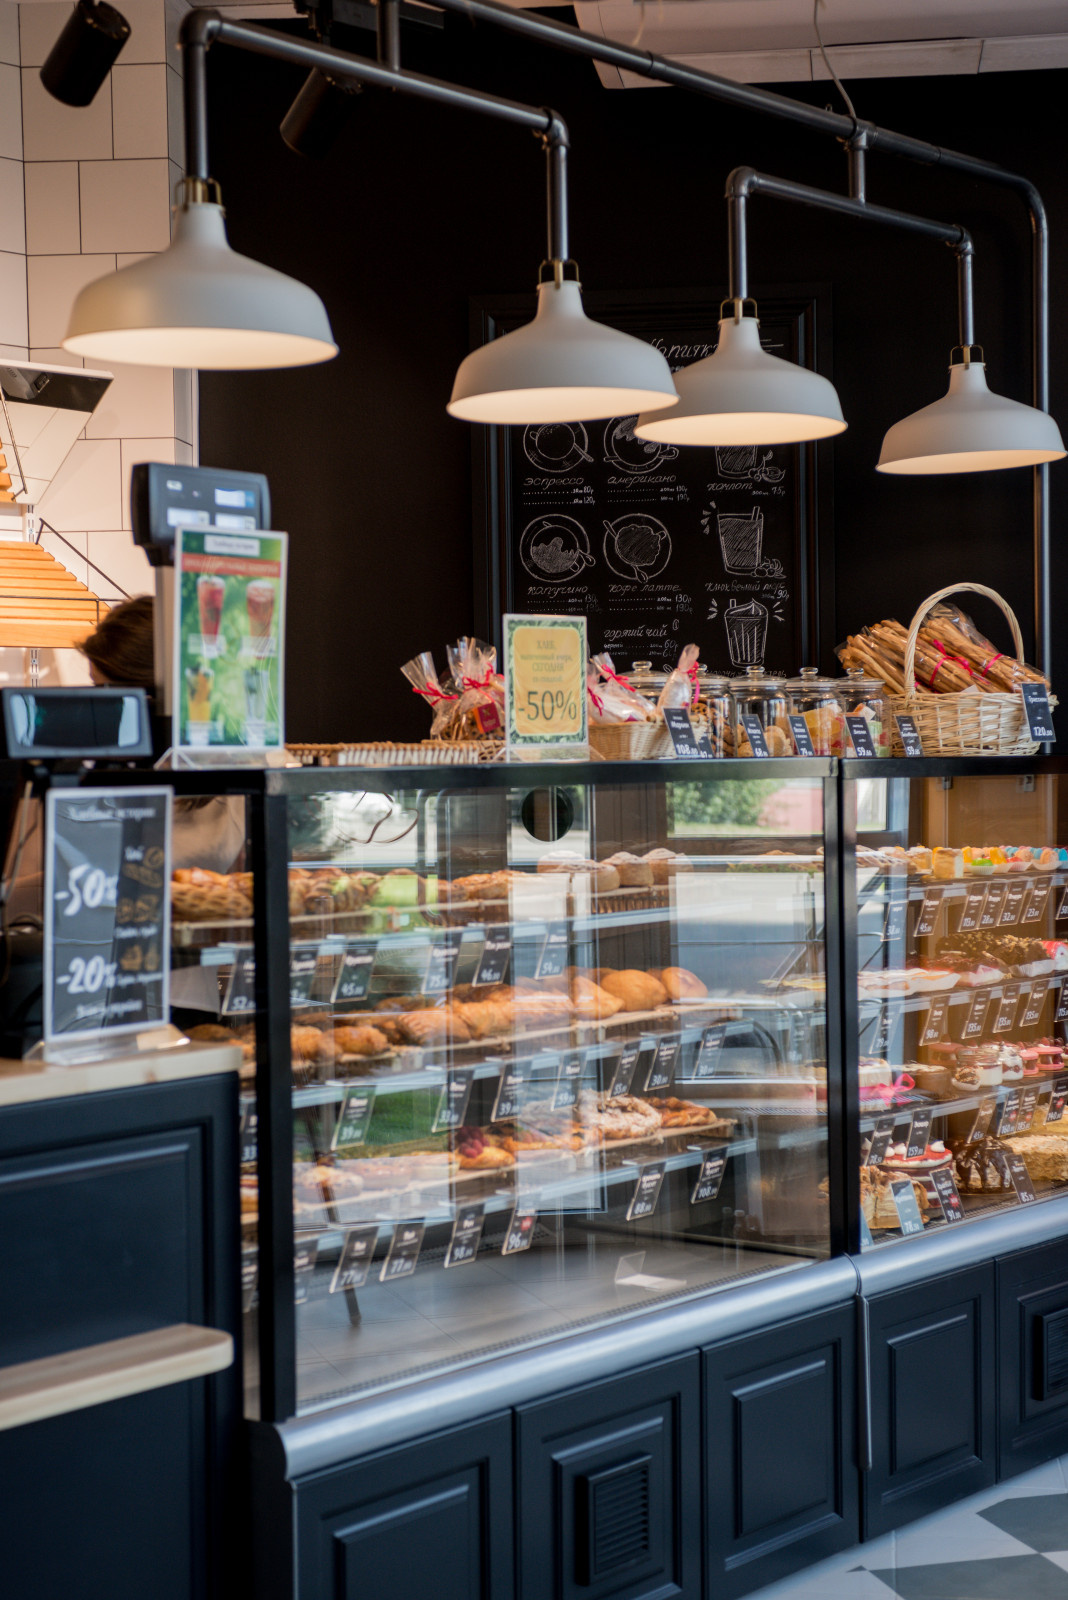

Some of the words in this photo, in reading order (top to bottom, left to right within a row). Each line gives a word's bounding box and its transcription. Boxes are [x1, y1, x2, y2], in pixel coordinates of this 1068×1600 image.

[607, 475, 677, 489] американо
[518, 690, 577, 721] -50%
[55, 955, 118, 994] -20%
